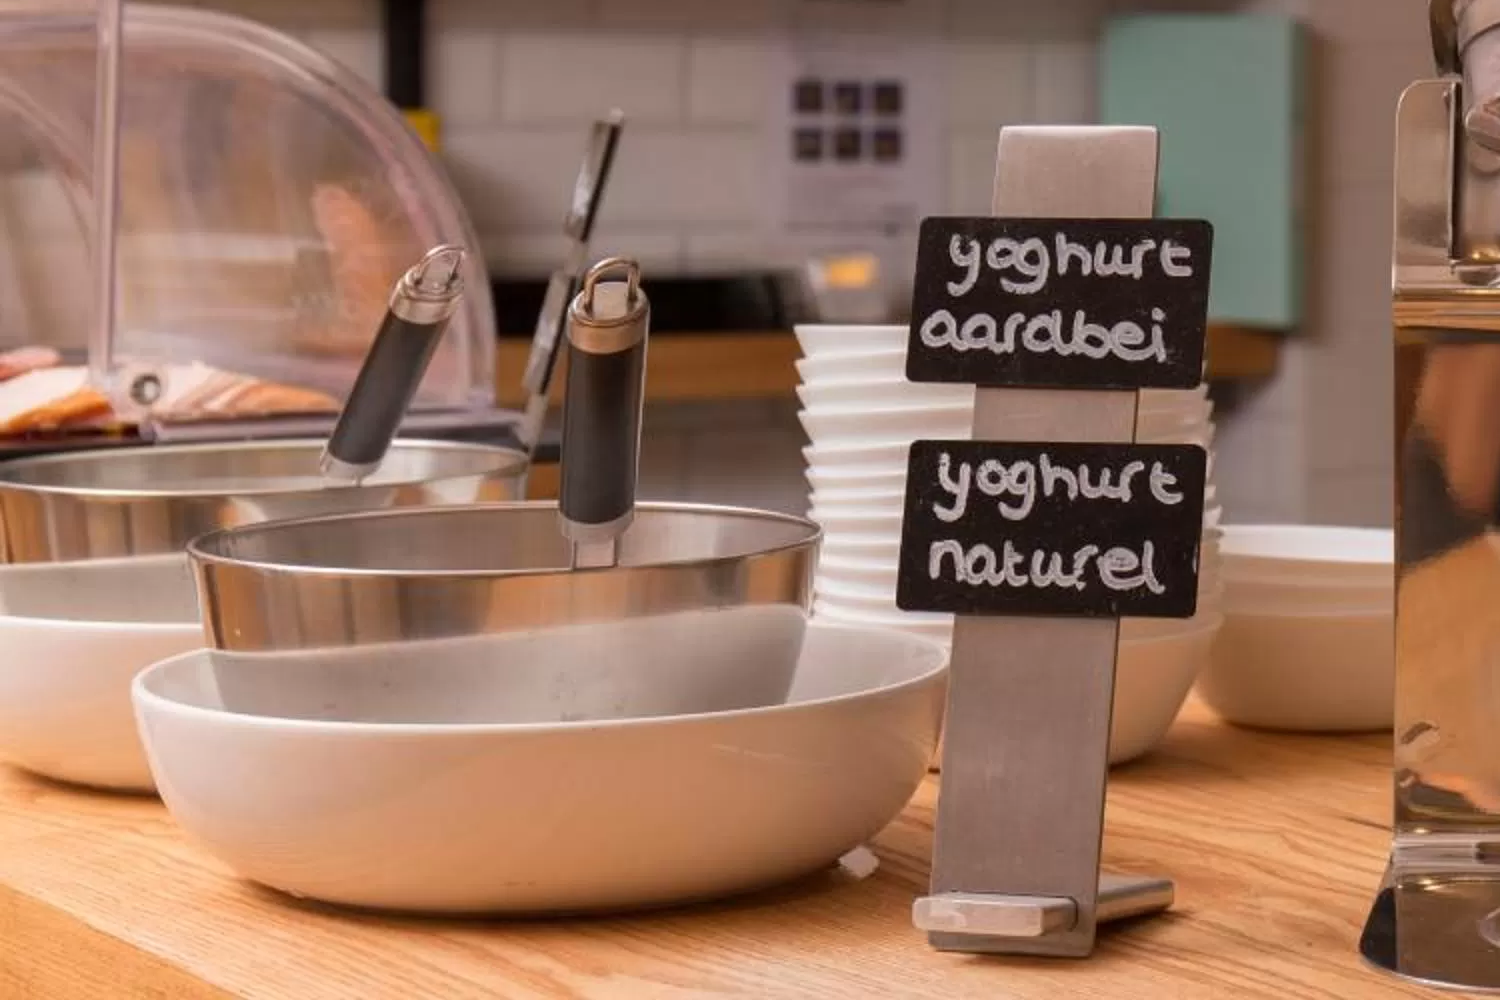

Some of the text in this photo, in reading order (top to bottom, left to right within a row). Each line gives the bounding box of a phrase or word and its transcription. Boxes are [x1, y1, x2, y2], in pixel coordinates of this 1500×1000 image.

[947, 232, 1193, 296] yoghurt
[920, 307, 1167, 363] aardbei
[933, 452, 1183, 522] yoghurt
[929, 539, 1165, 594] naturel
